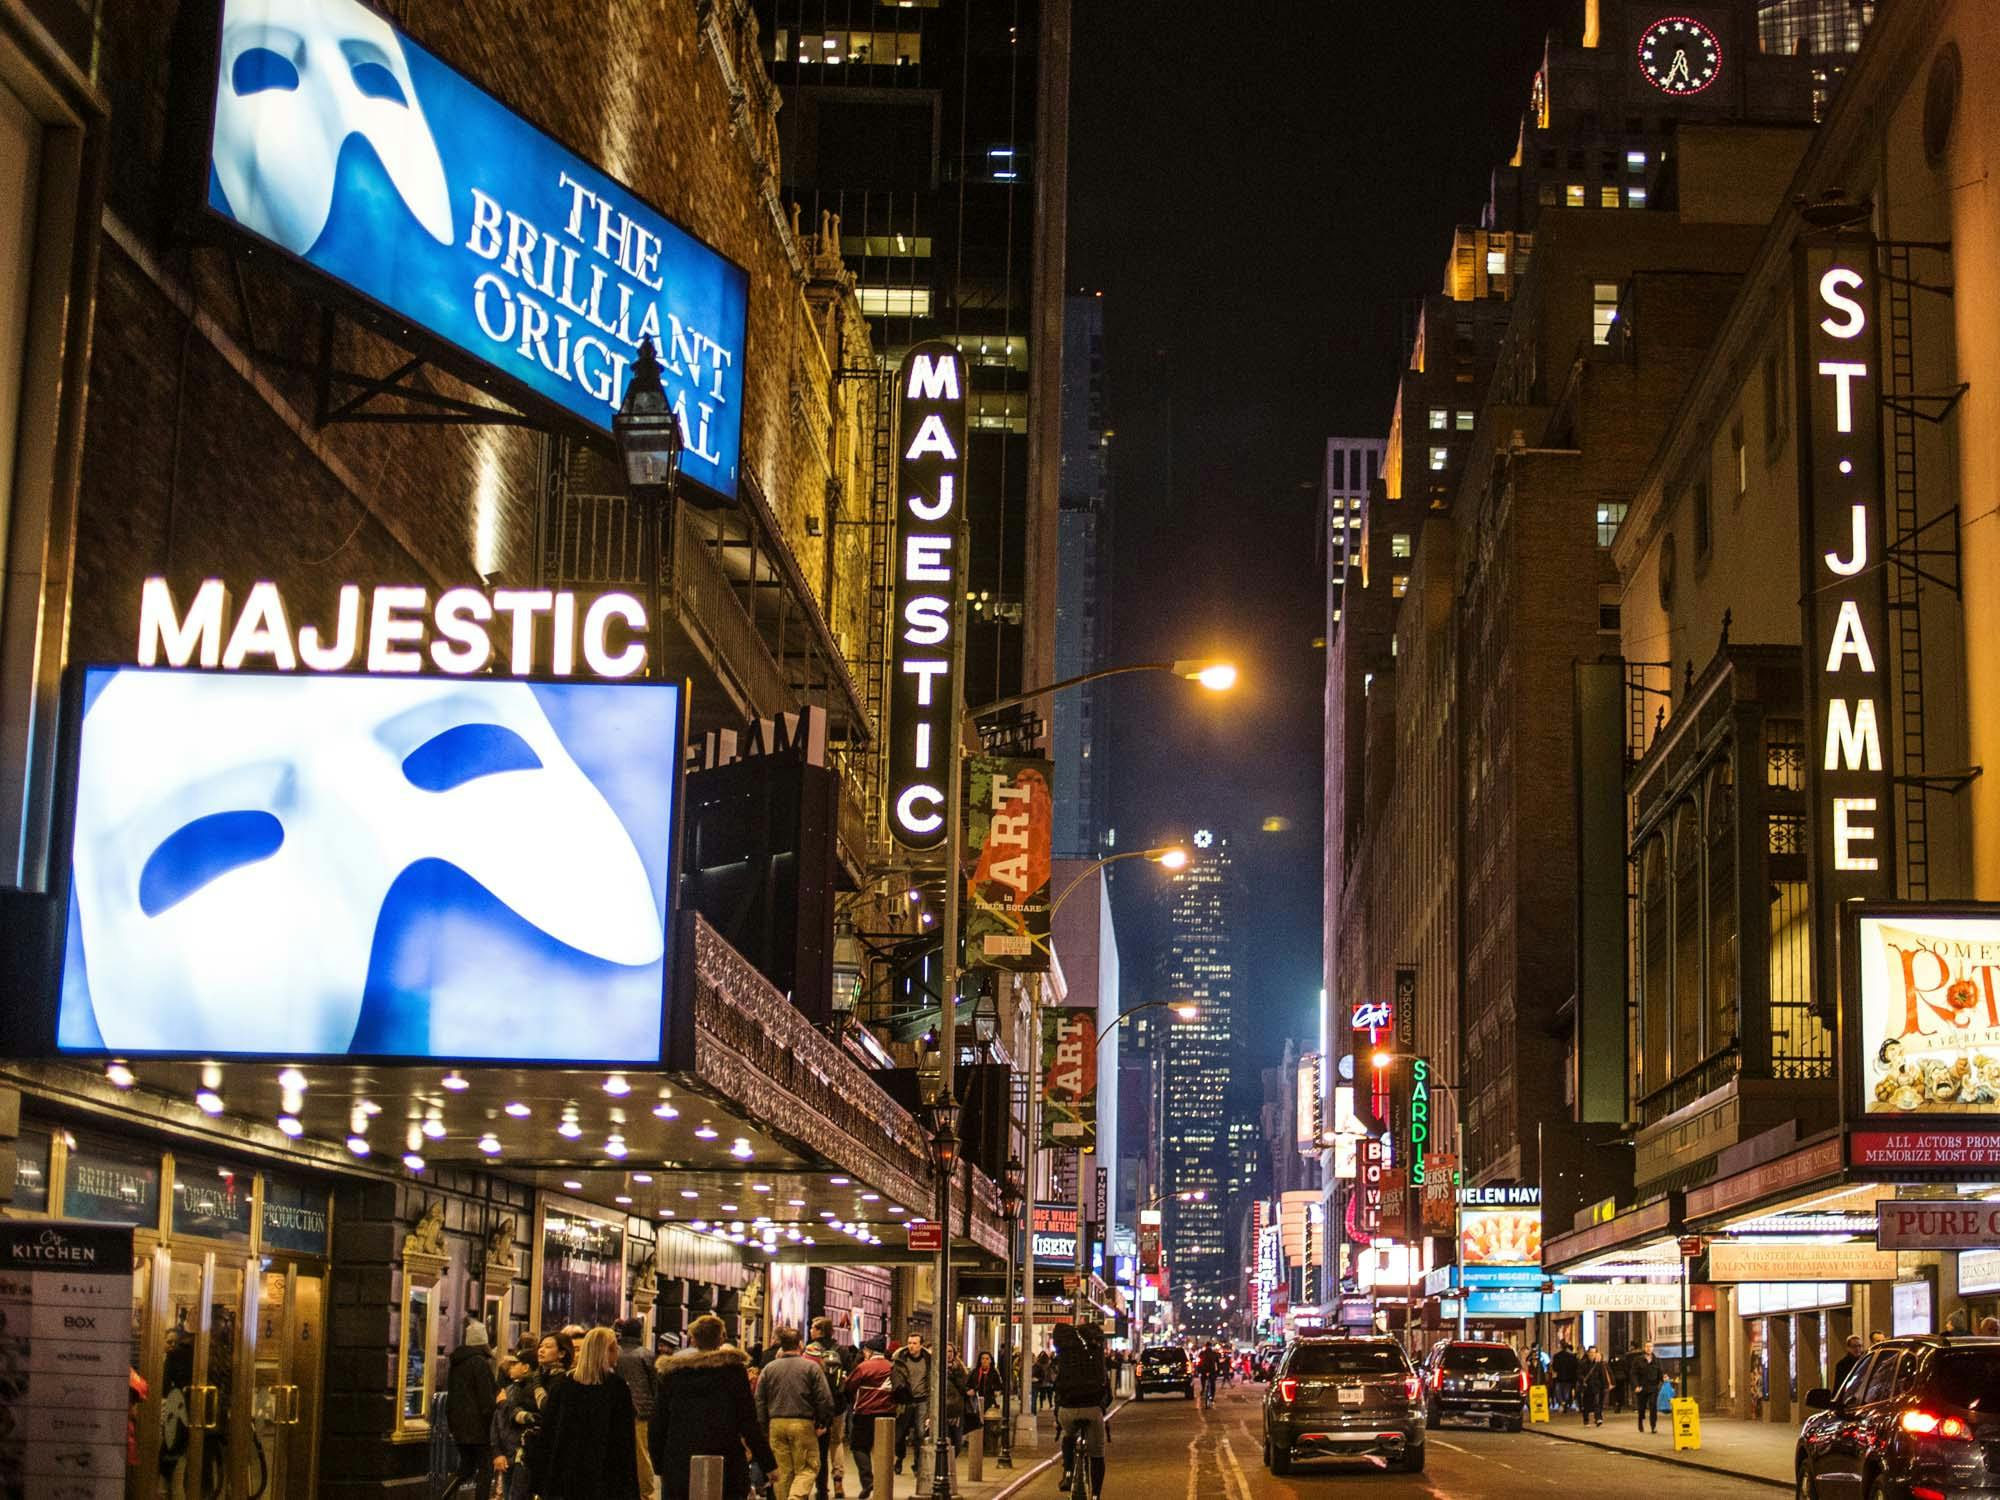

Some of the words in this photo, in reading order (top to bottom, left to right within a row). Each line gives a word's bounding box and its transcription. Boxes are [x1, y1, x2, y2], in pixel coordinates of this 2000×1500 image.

[559, 171, 663, 292] THE
[465, 188, 731, 403] BRILLIANT
[473, 273, 720, 466] ORIGIAL
[896, 355, 960, 833] MAJESTIC
[137, 576, 648, 678] MAJESTIC
[990, 774, 1031, 893] ART
[1004, 894, 1013, 902] in
[1006, 903, 1042, 912] SQUARE
[1057, 1018, 1082, 1094] ART
[1866, 1149, 1931, 1162] MEMORIZE
[1935, 1149, 1967, 1162] MOST
[1970, 1149, 1984, 1162] OF
[1886, 1136, 1911, 1148] ALL
[1917, 1135, 1962, 1148] ACTORS
[78, 1165, 146, 1205] BRILLIANT
[1424, 1167, 1453, 1186] JERSEY
[1427, 1183, 1449, 1200] BOYS
[183, 1184, 239, 1220] ORIGINAL
[263, 1201, 325, 1233] PRODUCTION
[12, 1245, 95, 1260] KITCHEN
[1714, 1261, 1770, 1272] VALENTINE
[1787, 1261, 1840, 1272] BROADWAY
[64, 1316, 96, 1329] BOX
